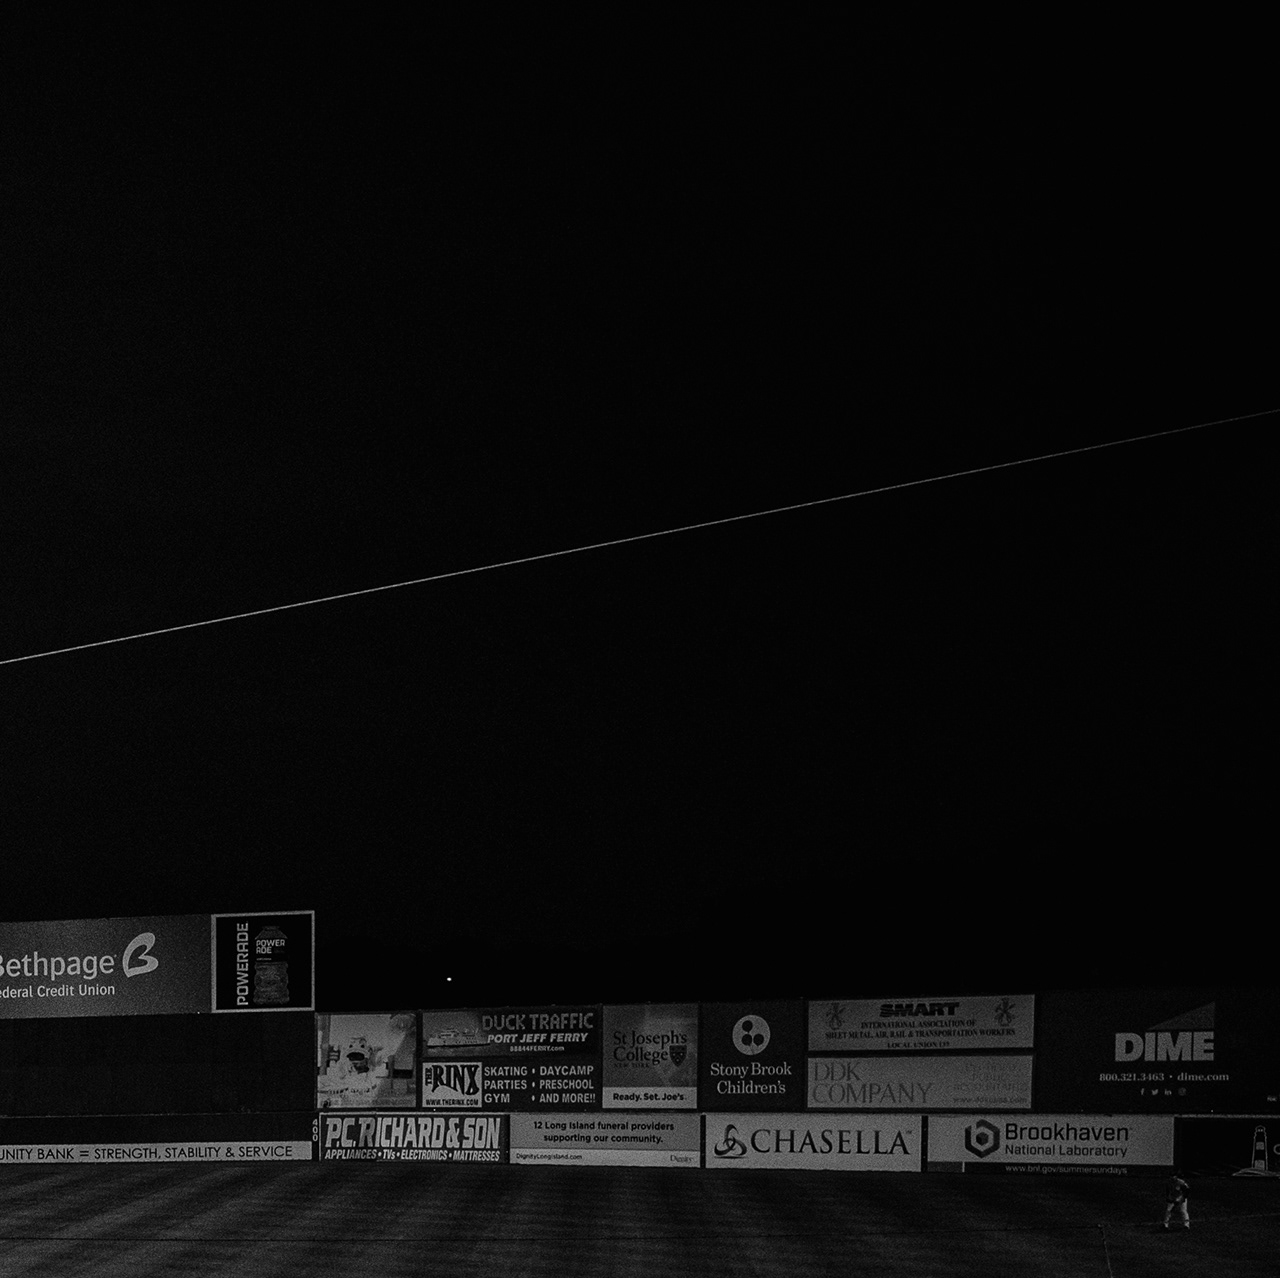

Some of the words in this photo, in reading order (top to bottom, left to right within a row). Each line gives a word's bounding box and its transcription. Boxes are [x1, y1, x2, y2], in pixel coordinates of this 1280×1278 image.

[255, 939, 286, 947] POWER
[236, 921, 250, 1006] POWERADE
[37, 984, 75, 997] Credit
[78, 983, 116, 997] Union
[879, 1002, 960, 1018] SMART
[481, 1014, 526, 1031] DUCK
[528, 1013, 595, 1030] TRAFFIC
[487, 1033, 518, 1044] PORT
[519, 1033, 547, 1043] JEFF
[549, 1032, 589, 1043] FERRY
[613, 1031, 628, 1045] St
[630, 1030, 688, 1049] Joseph's
[1114, 1031, 1215, 1062] DIME
[613, 1047, 669, 1065] College
[483, 1066, 528, 1077] SKATING
[539, 1065, 595, 1076] DAYCAMP
[710, 1062, 749, 1078] Stony
[750, 1061, 793, 1076] Brook
[814, 1062, 861, 1081] DDK
[1099, 1072, 1165, 1082] 800.321.3463
[1176, 1072, 1230, 1081] dime.com
[431, 1065, 480, 1096] RINX
[483, 1079, 528, 1090] PARTIES
[539, 1079, 595, 1090] PRESCHOOL
[716, 1080, 787, 1095] Children's
[483, 1093, 511, 1104] GYM
[539, 1093, 560, 1103] AND
[561, 1093, 597, 1104] MORE!!
[613, 1092, 642, 1102] Ready.
[643, 1092, 659, 1101] Set.
[661, 1092, 684, 1101] Joe's
[812, 1083, 933, 1104] COMPANY
[358, 1117, 446, 1149] RICHARD
[446, 1117, 461, 1149] &
[462, 1117, 502, 1149] SON
[533, 1121, 543, 1130] 12
[545, 1121, 567, 1131] Long
[569, 1121, 596, 1130] Island
[597, 1121, 629, 1131] funeral
[631, 1122, 675, 1132] providers
[1005, 1122, 1129, 1142] Brookhaven
[543, 1133, 591, 1144] supporting
[611, 1134, 664, 1145] community.
[750, 1128, 910, 1155] CHASELLA
[37, 1147, 75, 1160] BANK
[94, 1147, 162, 1160] STRENGTH,
[164, 1146, 222, 1159] STABILITY
[225, 1146, 236, 1158] &
[238, 1145, 293, 1158] SERVICE
[324, 1149, 377, 1160] APPLIANCES
[383, 1149, 397, 1160] TVs
[400, 1149, 448, 1160] ELECTRONICS
[453, 1149, 501, 1161] MATTRESSES
[1005, 1144, 1055, 1156] National
[1059, 1144, 1128, 1158] Laboratory
[1005, 1164, 1128, 1175] www.bnl.gov/summersundays
